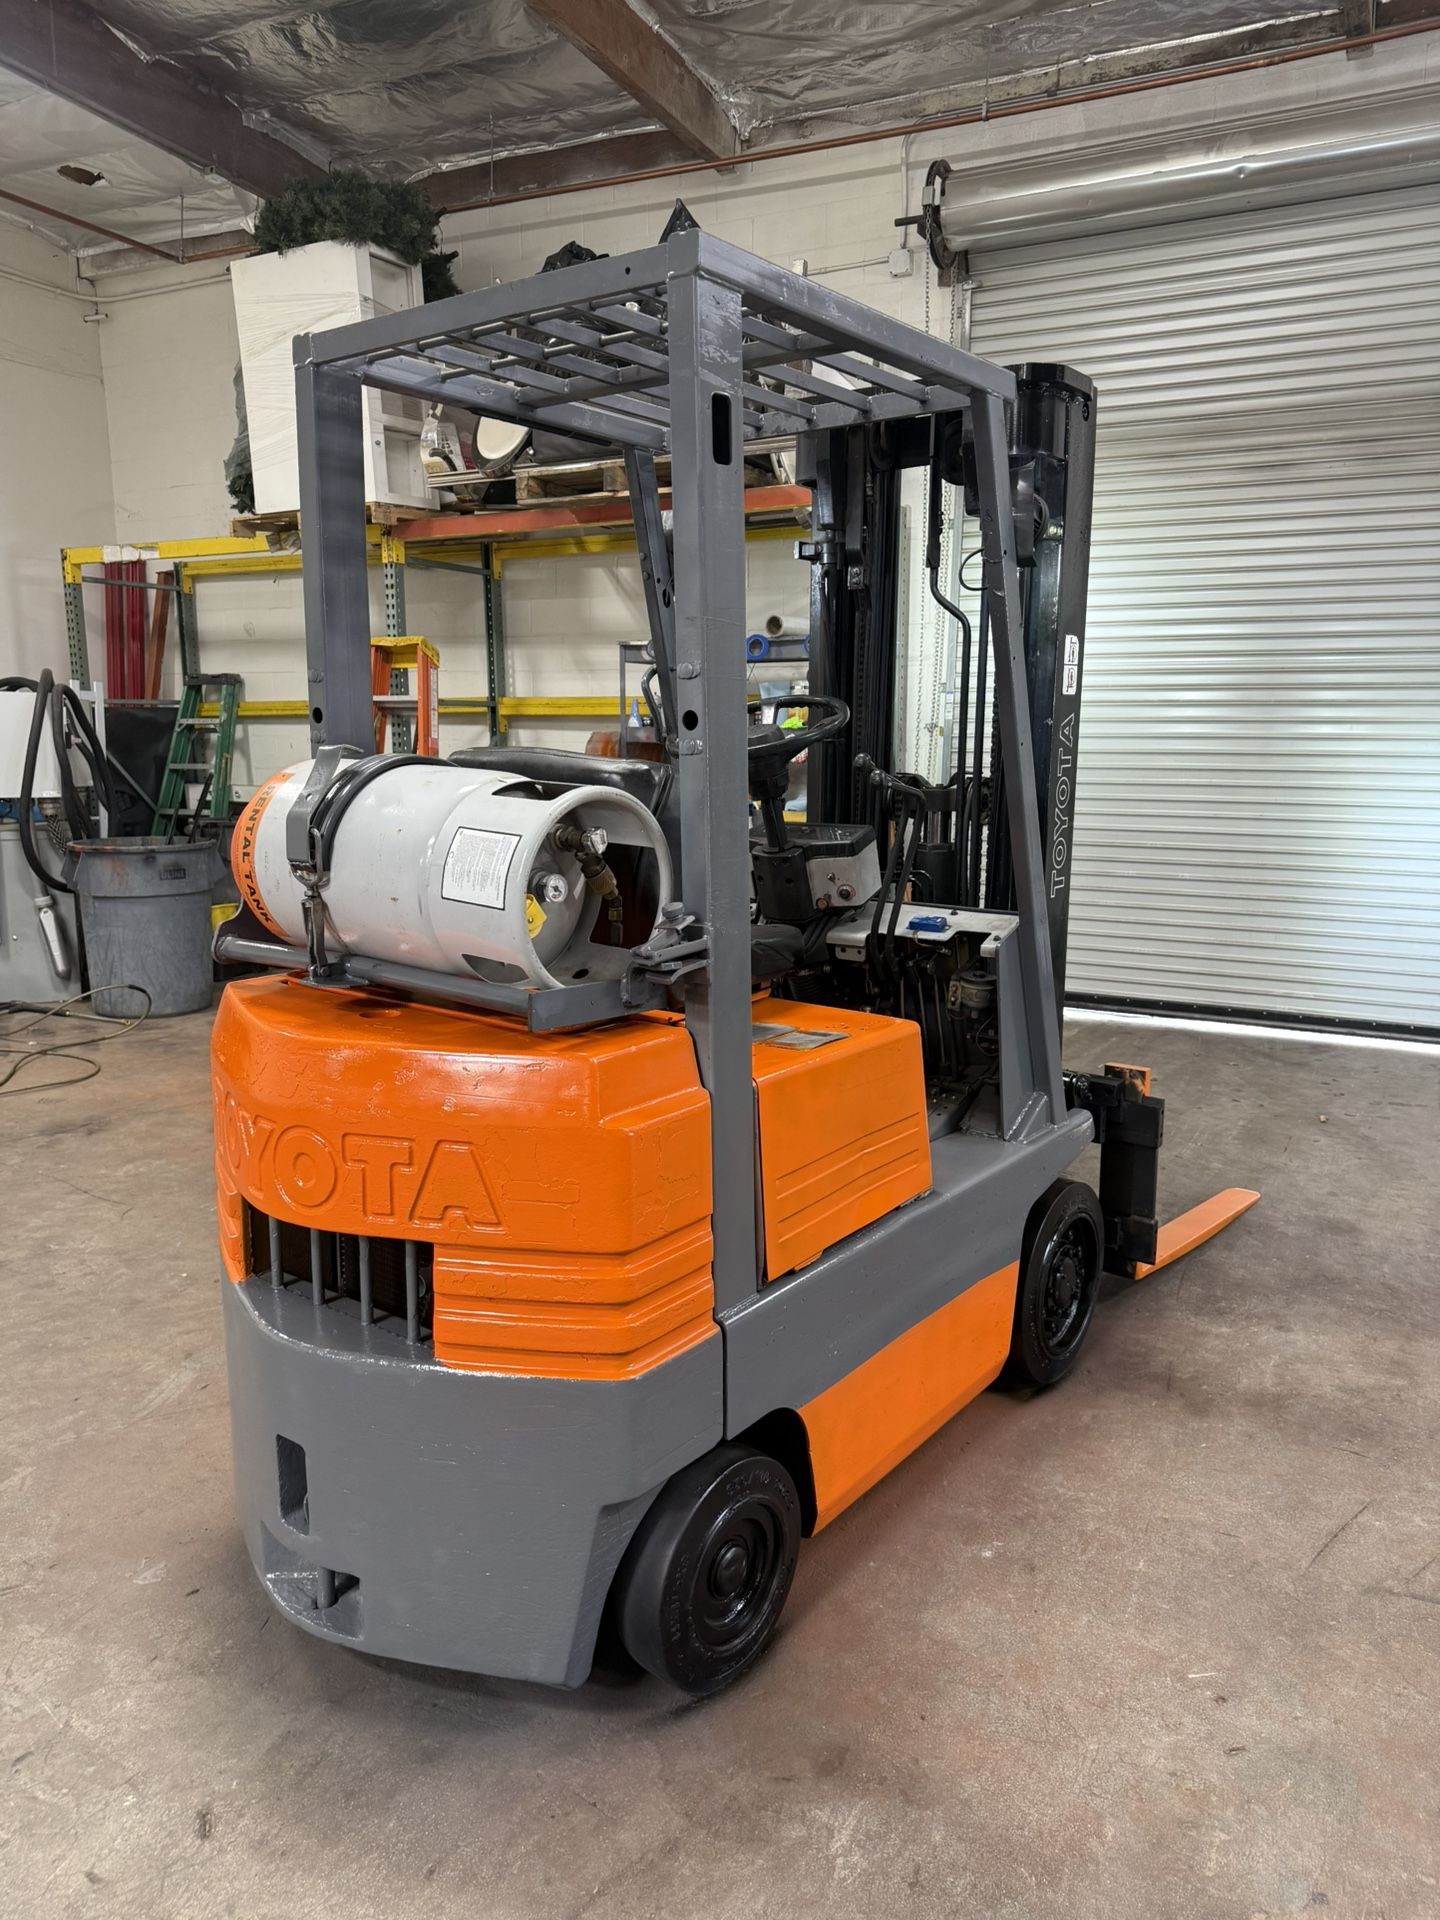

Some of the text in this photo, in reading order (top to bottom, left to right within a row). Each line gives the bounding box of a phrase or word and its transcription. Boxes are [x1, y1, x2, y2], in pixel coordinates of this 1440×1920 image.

[241, 784, 276, 924] RENTAL TANK
[1050, 712, 1075, 898] TOYOTA
